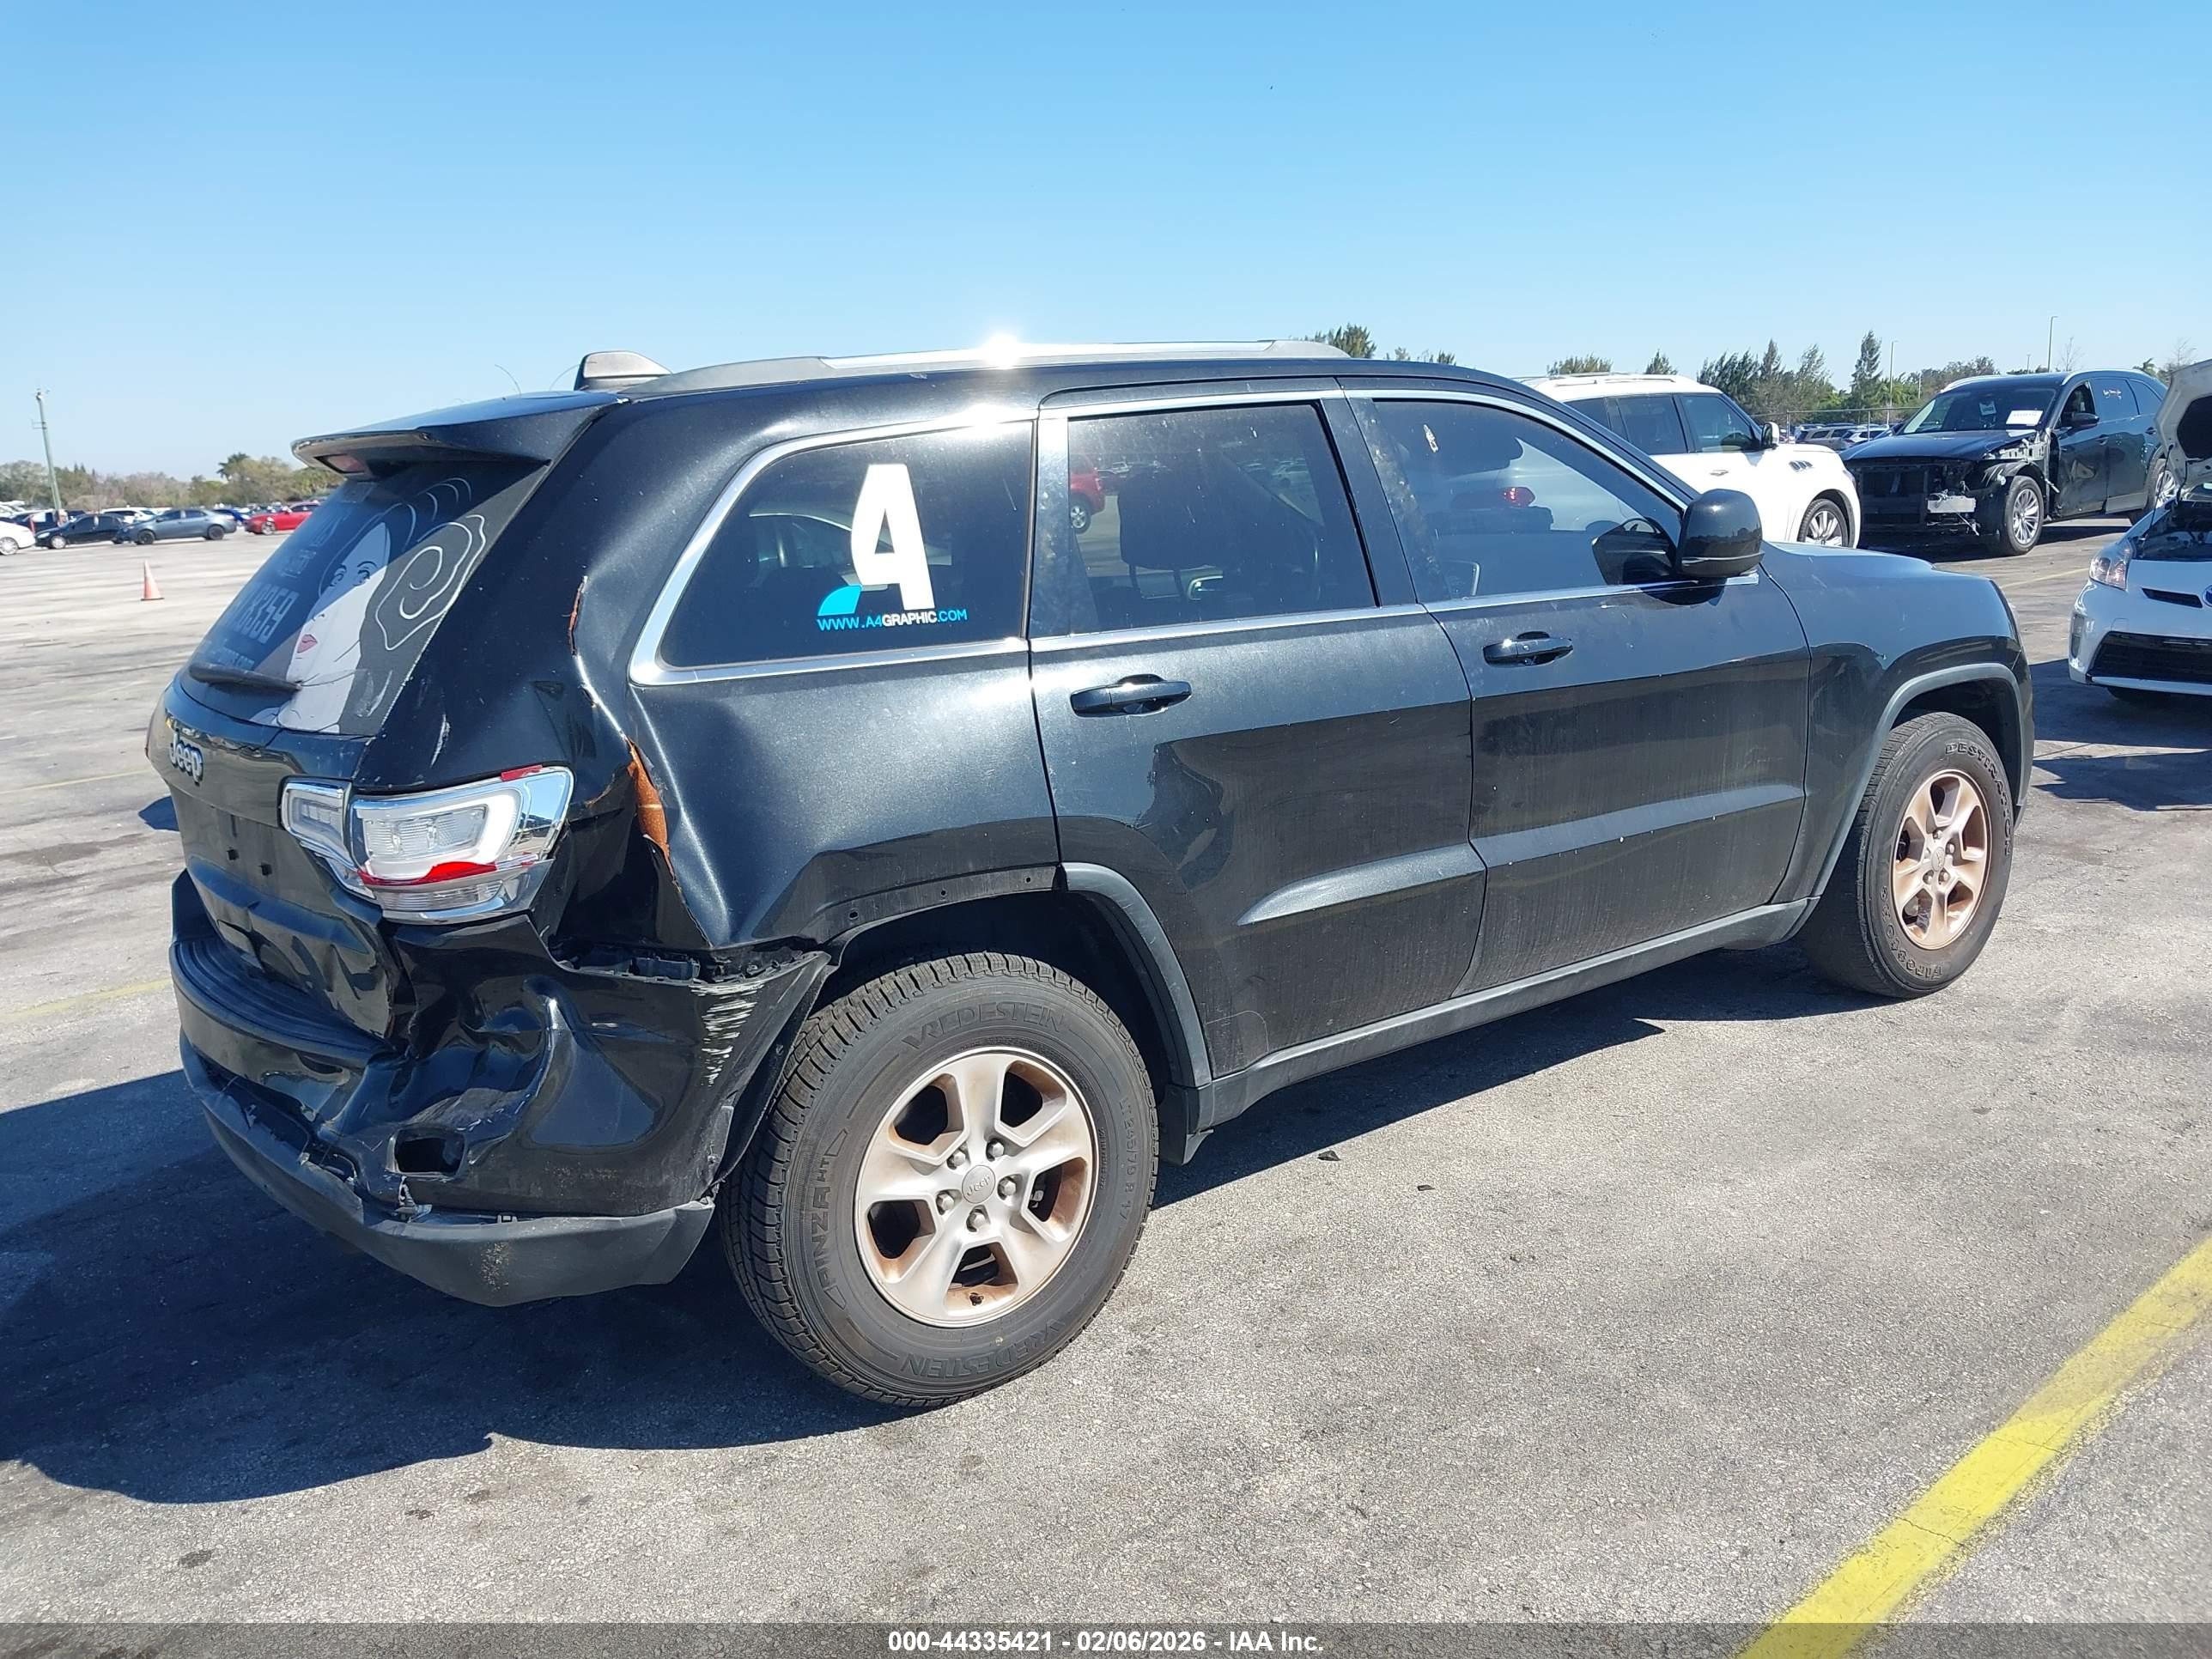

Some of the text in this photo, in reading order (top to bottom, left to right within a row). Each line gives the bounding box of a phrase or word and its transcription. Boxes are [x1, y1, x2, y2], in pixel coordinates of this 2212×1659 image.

[169, 732, 204, 787] Jeep
[1945, 742, 2011, 857] DESTINATION
[900, 1001, 1066, 1050] VREDESTEIN
[966, 1174, 990, 1197] Jeep
[811, 1156, 831, 1289] PINZA HT
